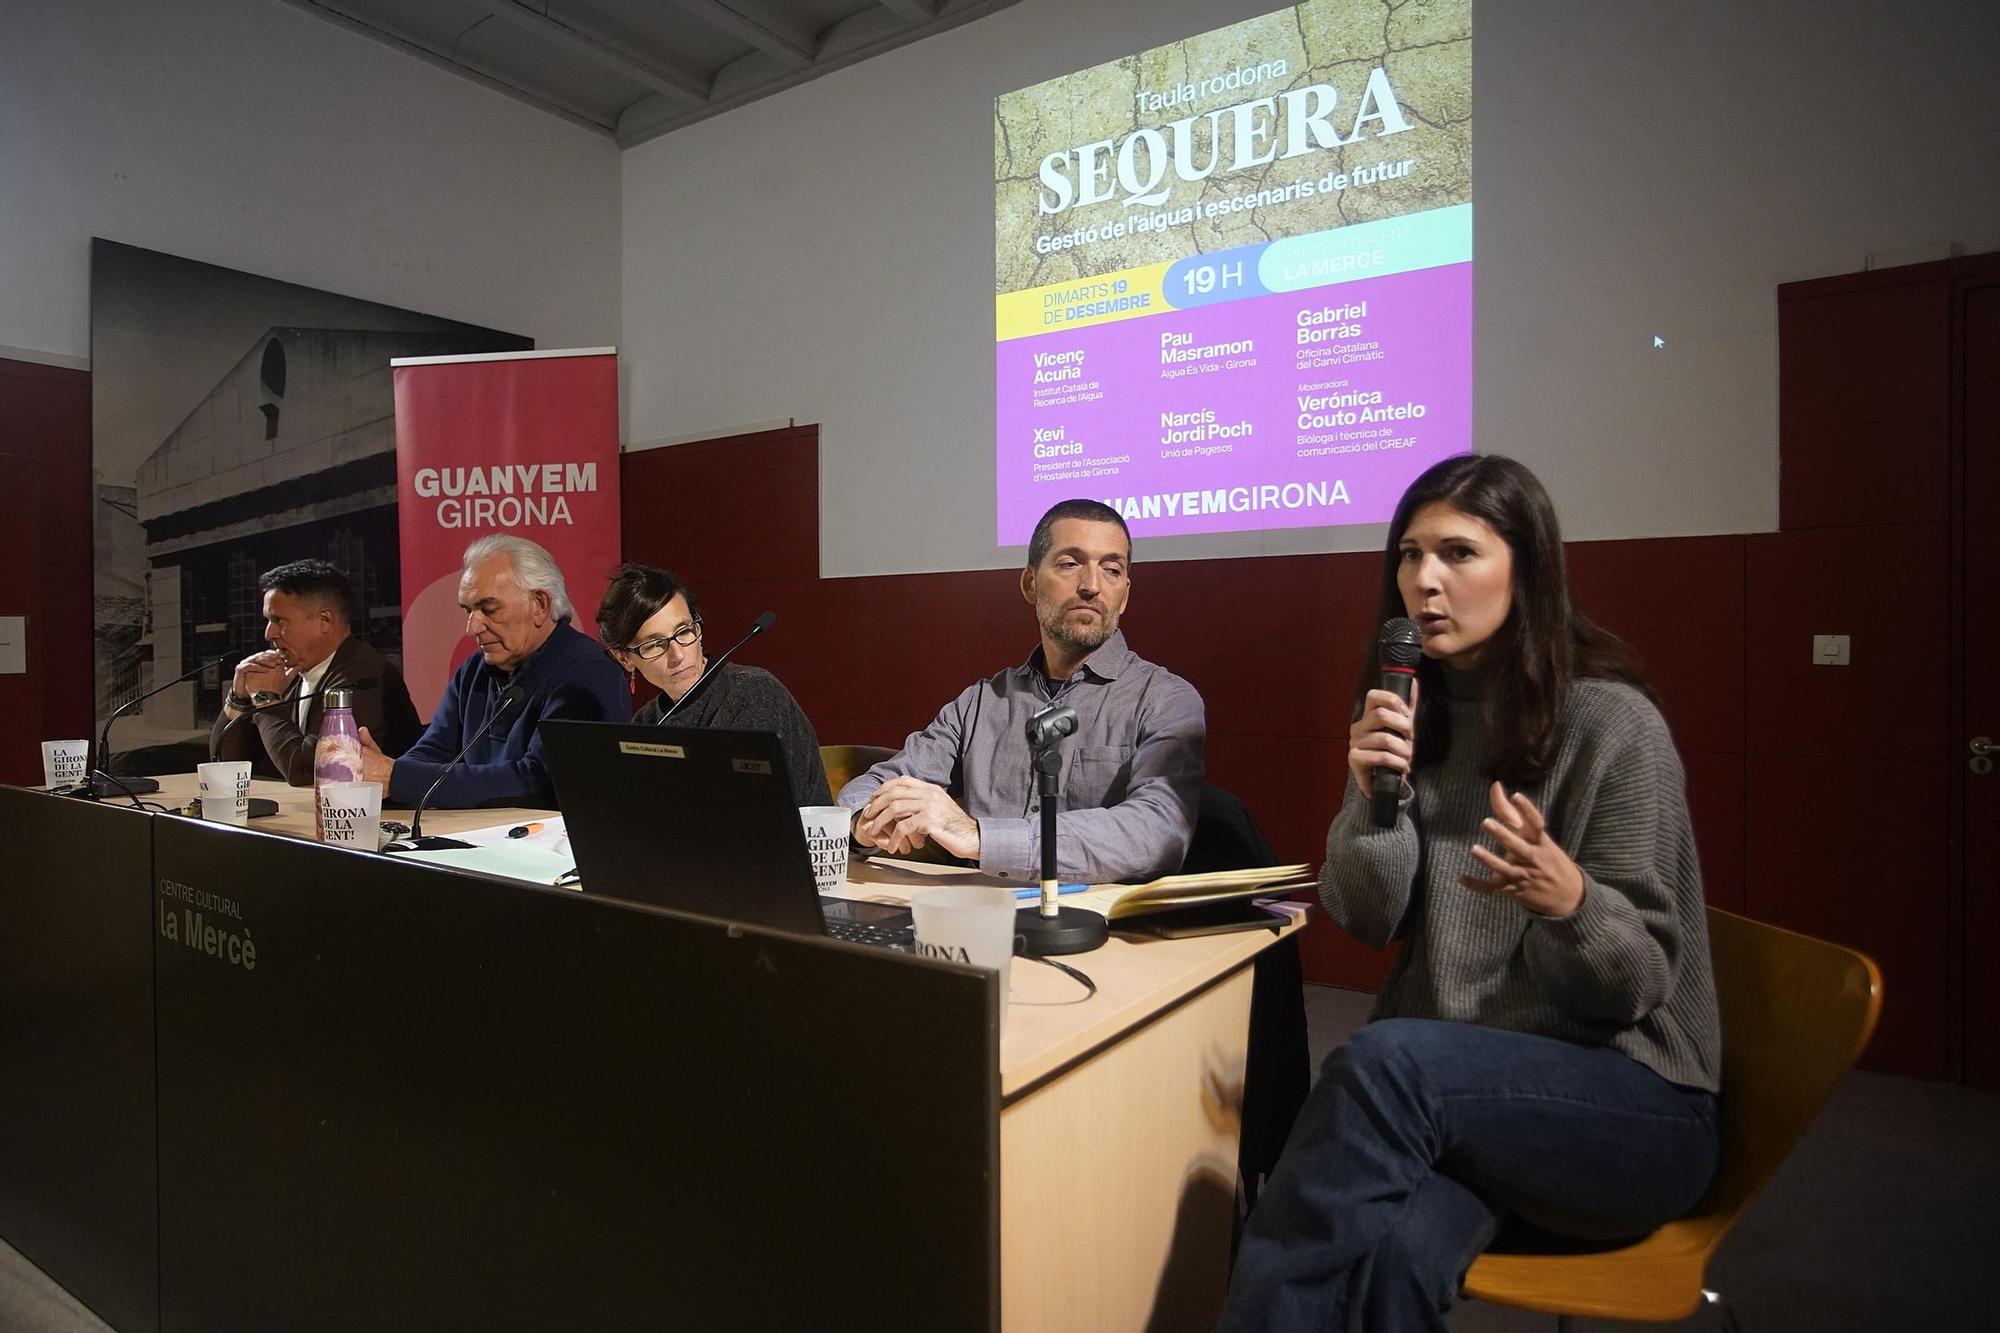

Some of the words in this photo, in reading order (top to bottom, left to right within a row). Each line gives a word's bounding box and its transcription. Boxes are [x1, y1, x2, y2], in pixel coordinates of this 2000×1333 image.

[1136, 82, 1195, 116] Taula
[1199, 58, 1287, 95] rodona
[1037, 67, 1415, 216] SEQUERA
[1036, 221, 1098, 255] Gestió
[1100, 217, 1126, 241] de
[1127, 203, 1194, 233] l'aigua
[1195, 201, 1203, 219] i
[1205, 181, 1316, 218] escenaris
[1318, 171, 1347, 195] de
[1352, 156, 1415, 187] futur
[1183, 266, 1216, 295] 19
[1221, 261, 1242, 288] H
[1283, 264, 1309, 281] LA
[1043, 282, 1109, 307] DIMARTS
[1111, 279, 1128, 296] 19
[1043, 309, 1063, 325] DE
[1065, 292, 1151, 321] DESEMBRE
[1296, 301, 1367, 326] Gabriel
[1161, 332, 1193, 348] Pau
[1296, 322, 1361, 345] Borràs
[1033, 349, 1085, 368] Vicenç
[1161, 339, 1254, 364] Masramon
[1296, 346, 1332, 360] Oficina
[1332, 341, 1378, 355] Catalana
[1161, 367, 1186, 379] Aigua
[1199, 362, 1219, 373] Vida
[1225, 358, 1257, 370] Girona
[1296, 358, 1312, 370] del
[1312, 354, 1341, 368] Canvi
[1033, 365, 1081, 384] Acuña
[1033, 385, 1062, 398] Institut
[1088, 380, 1100, 390] de
[1297, 380, 1349, 393] Moderadora
[1033, 395, 1066, 408] Recerca
[1066, 393, 1077, 403] de
[1297, 390, 1382, 412] Verónica
[1161, 408, 1216, 428] Narcís
[1297, 410, 1357, 430] Couto
[1359, 402, 1426, 424] Antelo
[1033, 425, 1065, 443] Xevi
[1161, 425, 1206, 444] Jordi
[1207, 420, 1253, 440] Poch
[1378, 427, 1393, 437] de
[1161, 446, 1181, 459] Unió
[1181, 448, 1193, 457] de
[1193, 443, 1233, 456] Pagesos
[1361, 441, 1378, 452] del
[1379, 436, 1417, 450] CREAF
[1033, 460, 1072, 472] President
[1071, 458, 1082, 468] de
[1080, 468, 1091, 478] de
[1092, 465, 1120, 477] Girona
[414, 462, 597, 498] GUANYEM
[1103, 479, 1351, 520] UANYEMGIRONA
[436, 495, 573, 529] GIRONA
[54, 763, 69, 771] DE
[335, 819, 353, 830] LA
[807, 826, 827, 838] LA
[325, 830, 355, 840] ENT!
[809, 852, 828, 864] DE
[831, 850, 845, 863] LA
[160, 879, 194, 903] CENTRE
[196, 889, 243, 920] CULTURAL
[160, 899, 178, 941] la
[185, 909, 256, 970] Mercè
